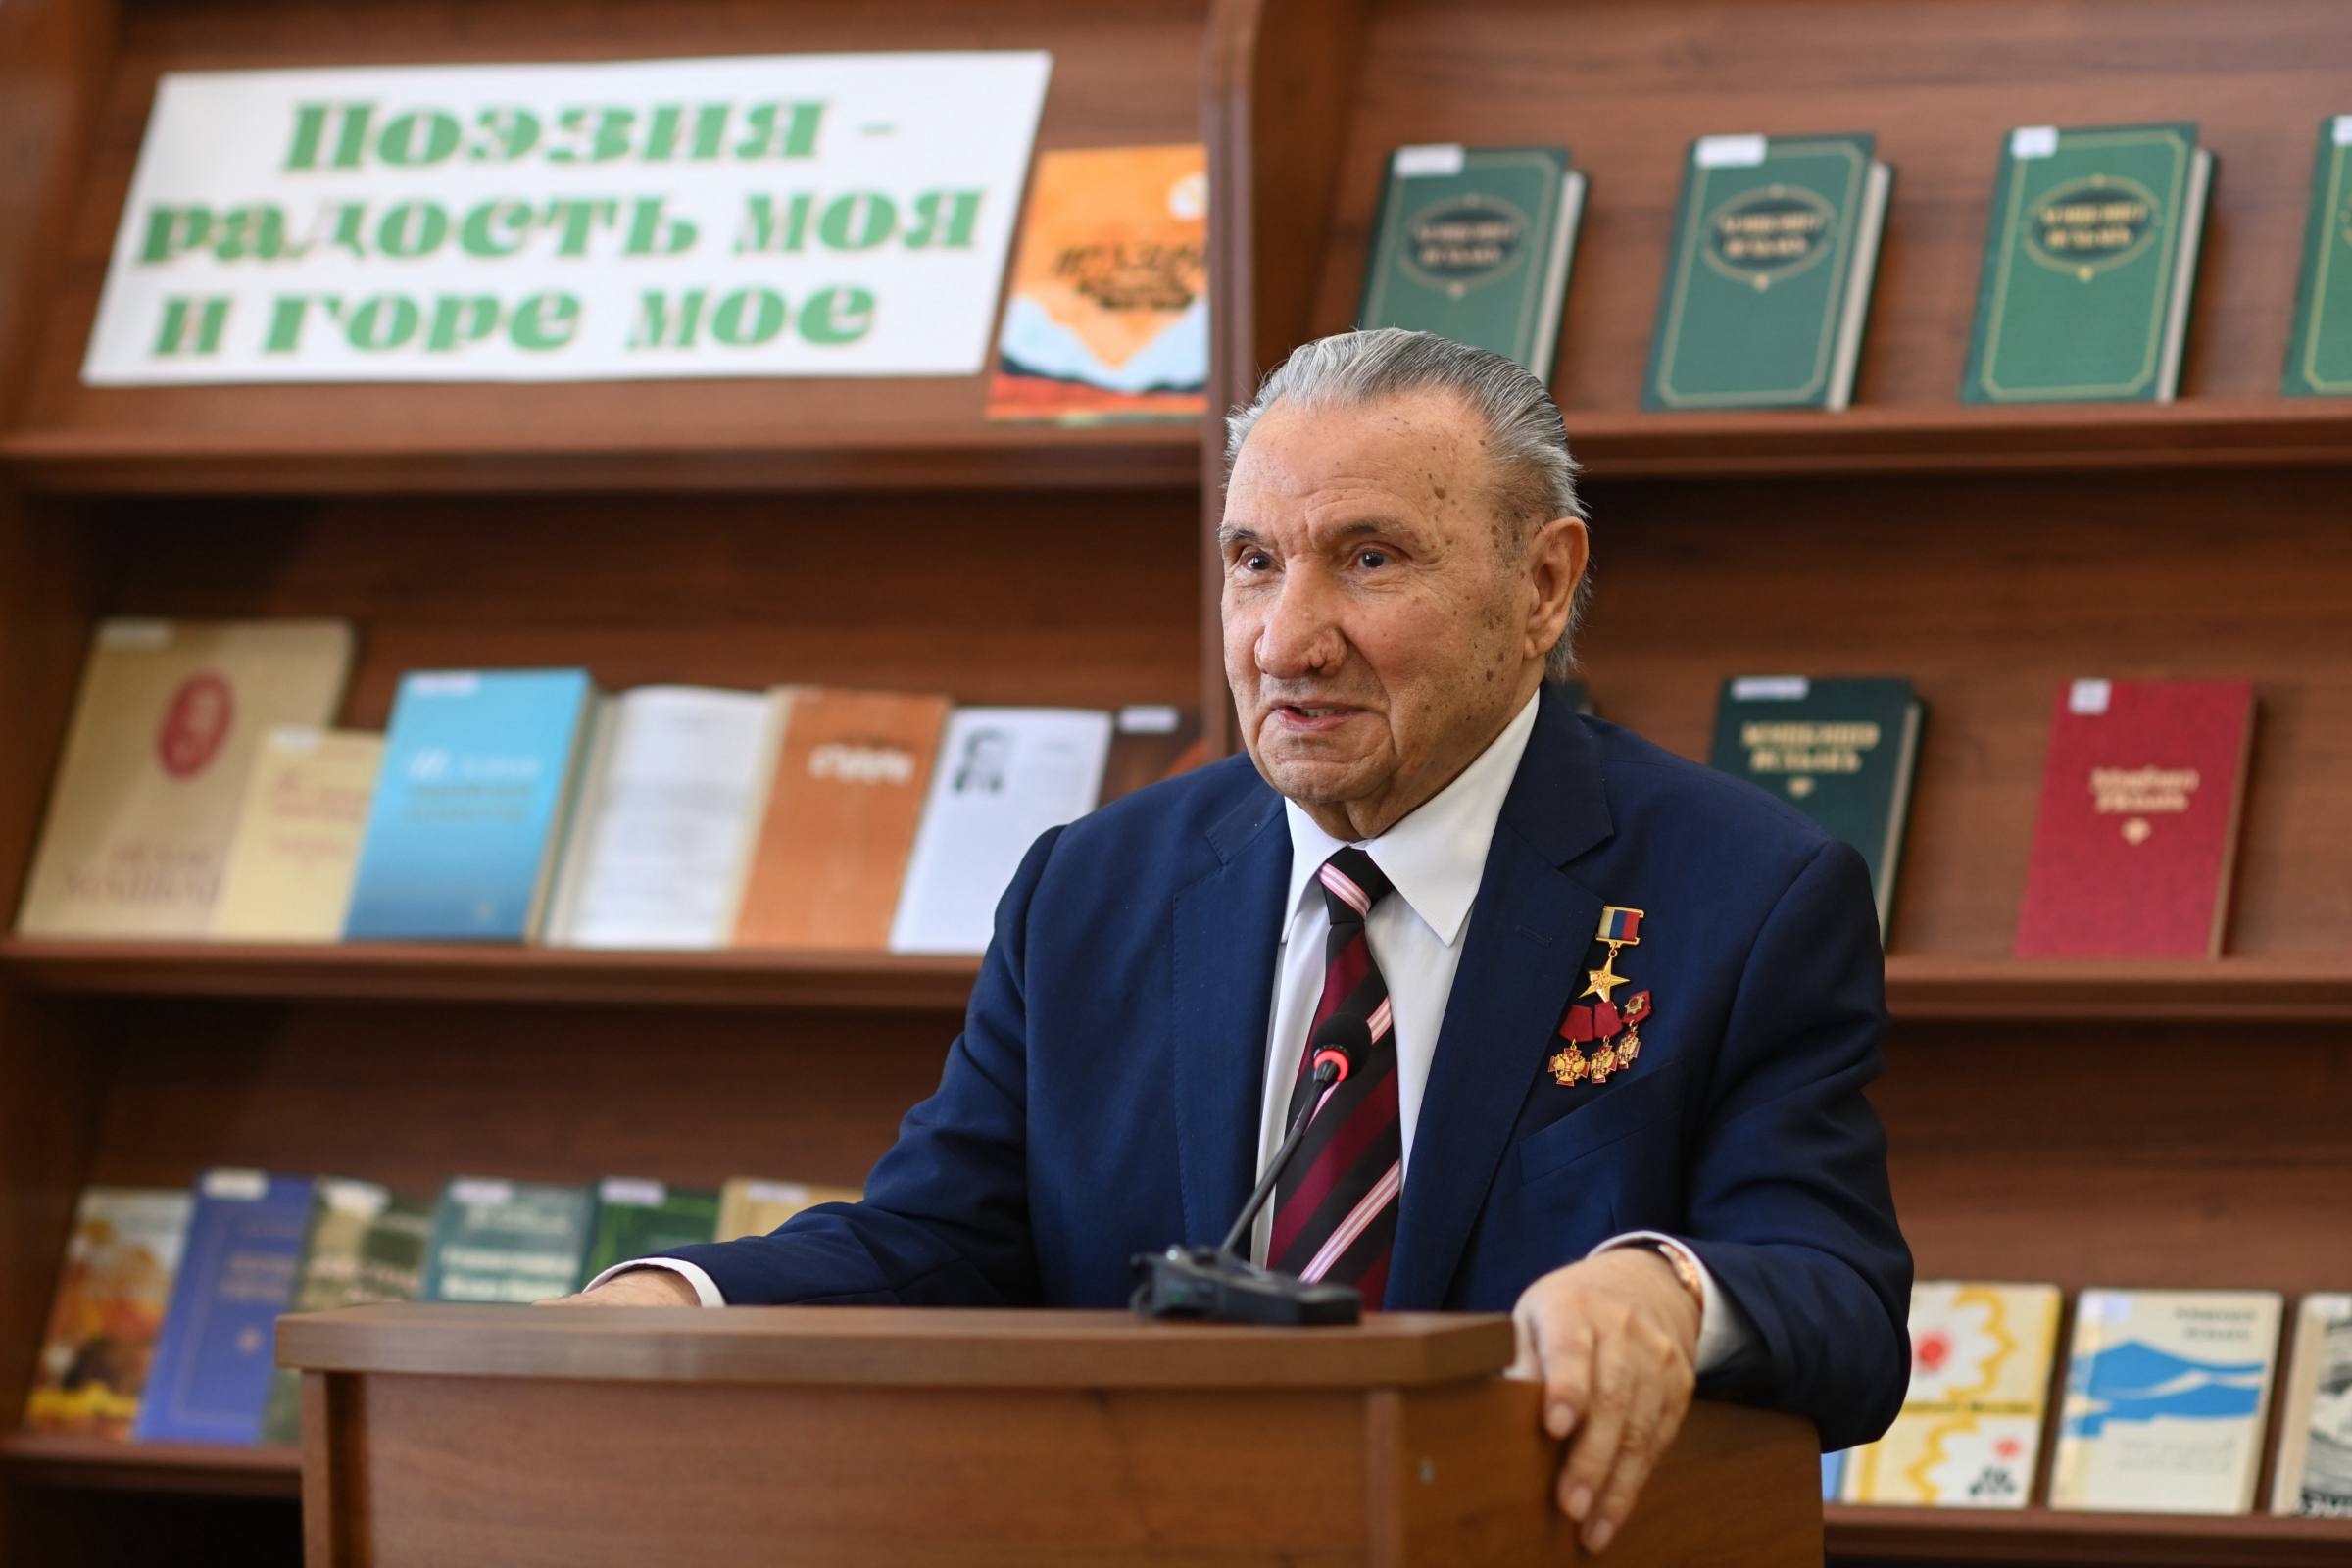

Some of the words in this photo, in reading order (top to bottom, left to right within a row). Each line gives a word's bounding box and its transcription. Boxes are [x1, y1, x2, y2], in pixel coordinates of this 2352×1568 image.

[283, 98, 827, 172] Поэзия
[136, 191, 699, 265] радость
[729, 188, 984, 254] моя
[151, 295, 230, 356] и
[261, 290, 584, 354] горе
[623, 283, 878, 350] мое
